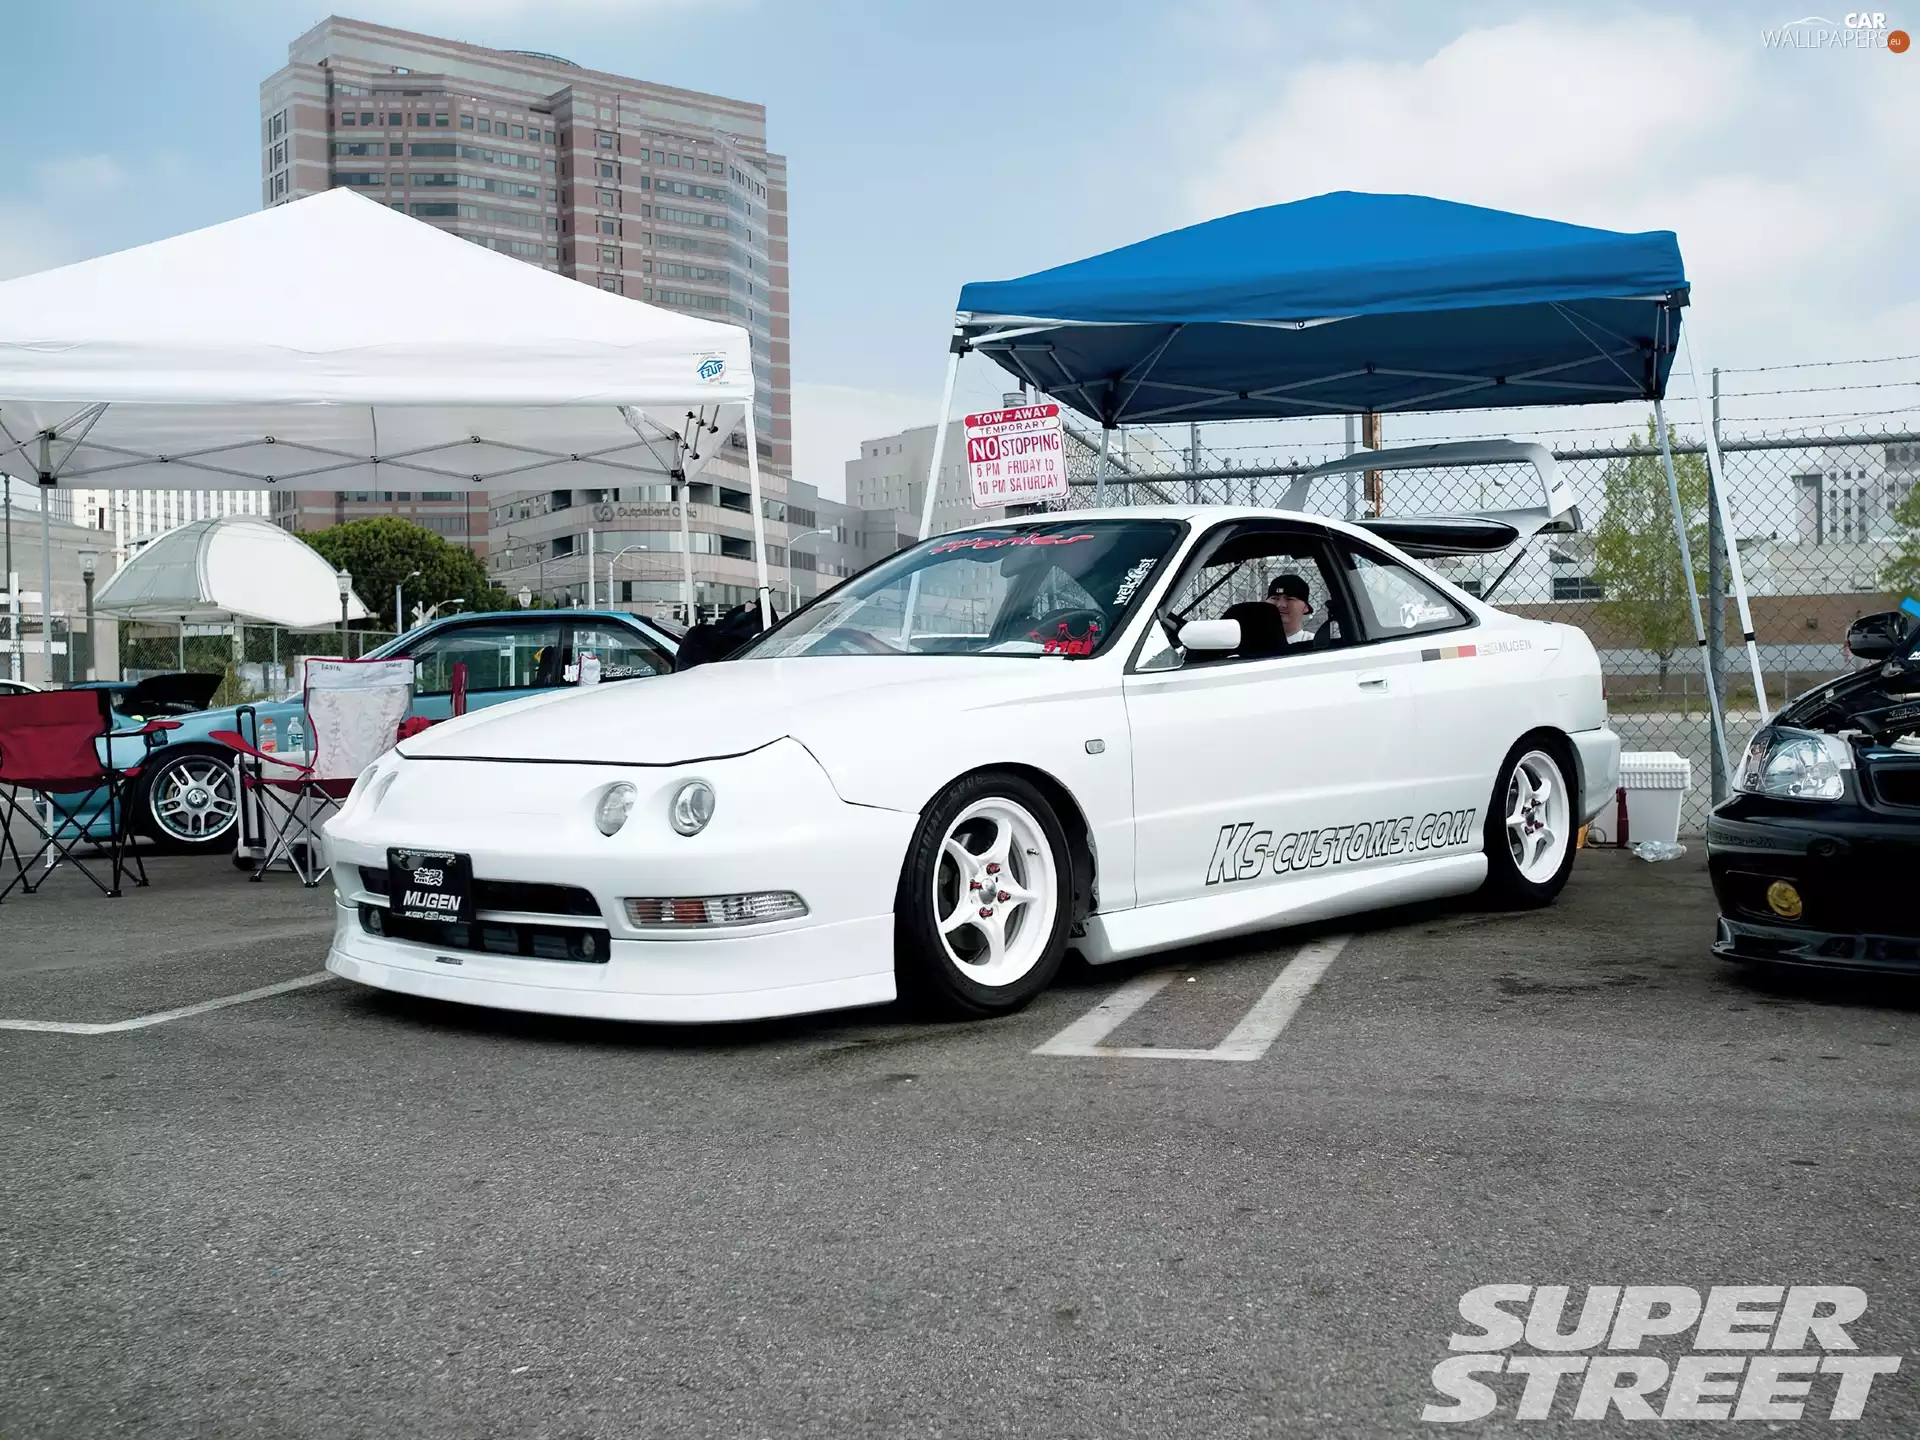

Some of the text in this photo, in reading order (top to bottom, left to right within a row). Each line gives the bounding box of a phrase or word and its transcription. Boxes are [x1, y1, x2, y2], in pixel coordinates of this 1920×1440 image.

[975, 406, 1049, 425] TOW-AWAY
[979, 419, 1047, 436] TEMPORARY
[970, 433, 1059, 462] NO STOPPING
[985, 462, 1000, 477] PM
[1007, 458, 1041, 475] FRIDAY
[1045, 458, 1054, 472] to
[978, 474, 1059, 496] 10 PM SATURDAY
[1498, 639, 1533, 653] MUGEN
[403, 889, 462, 911] MUGEN
